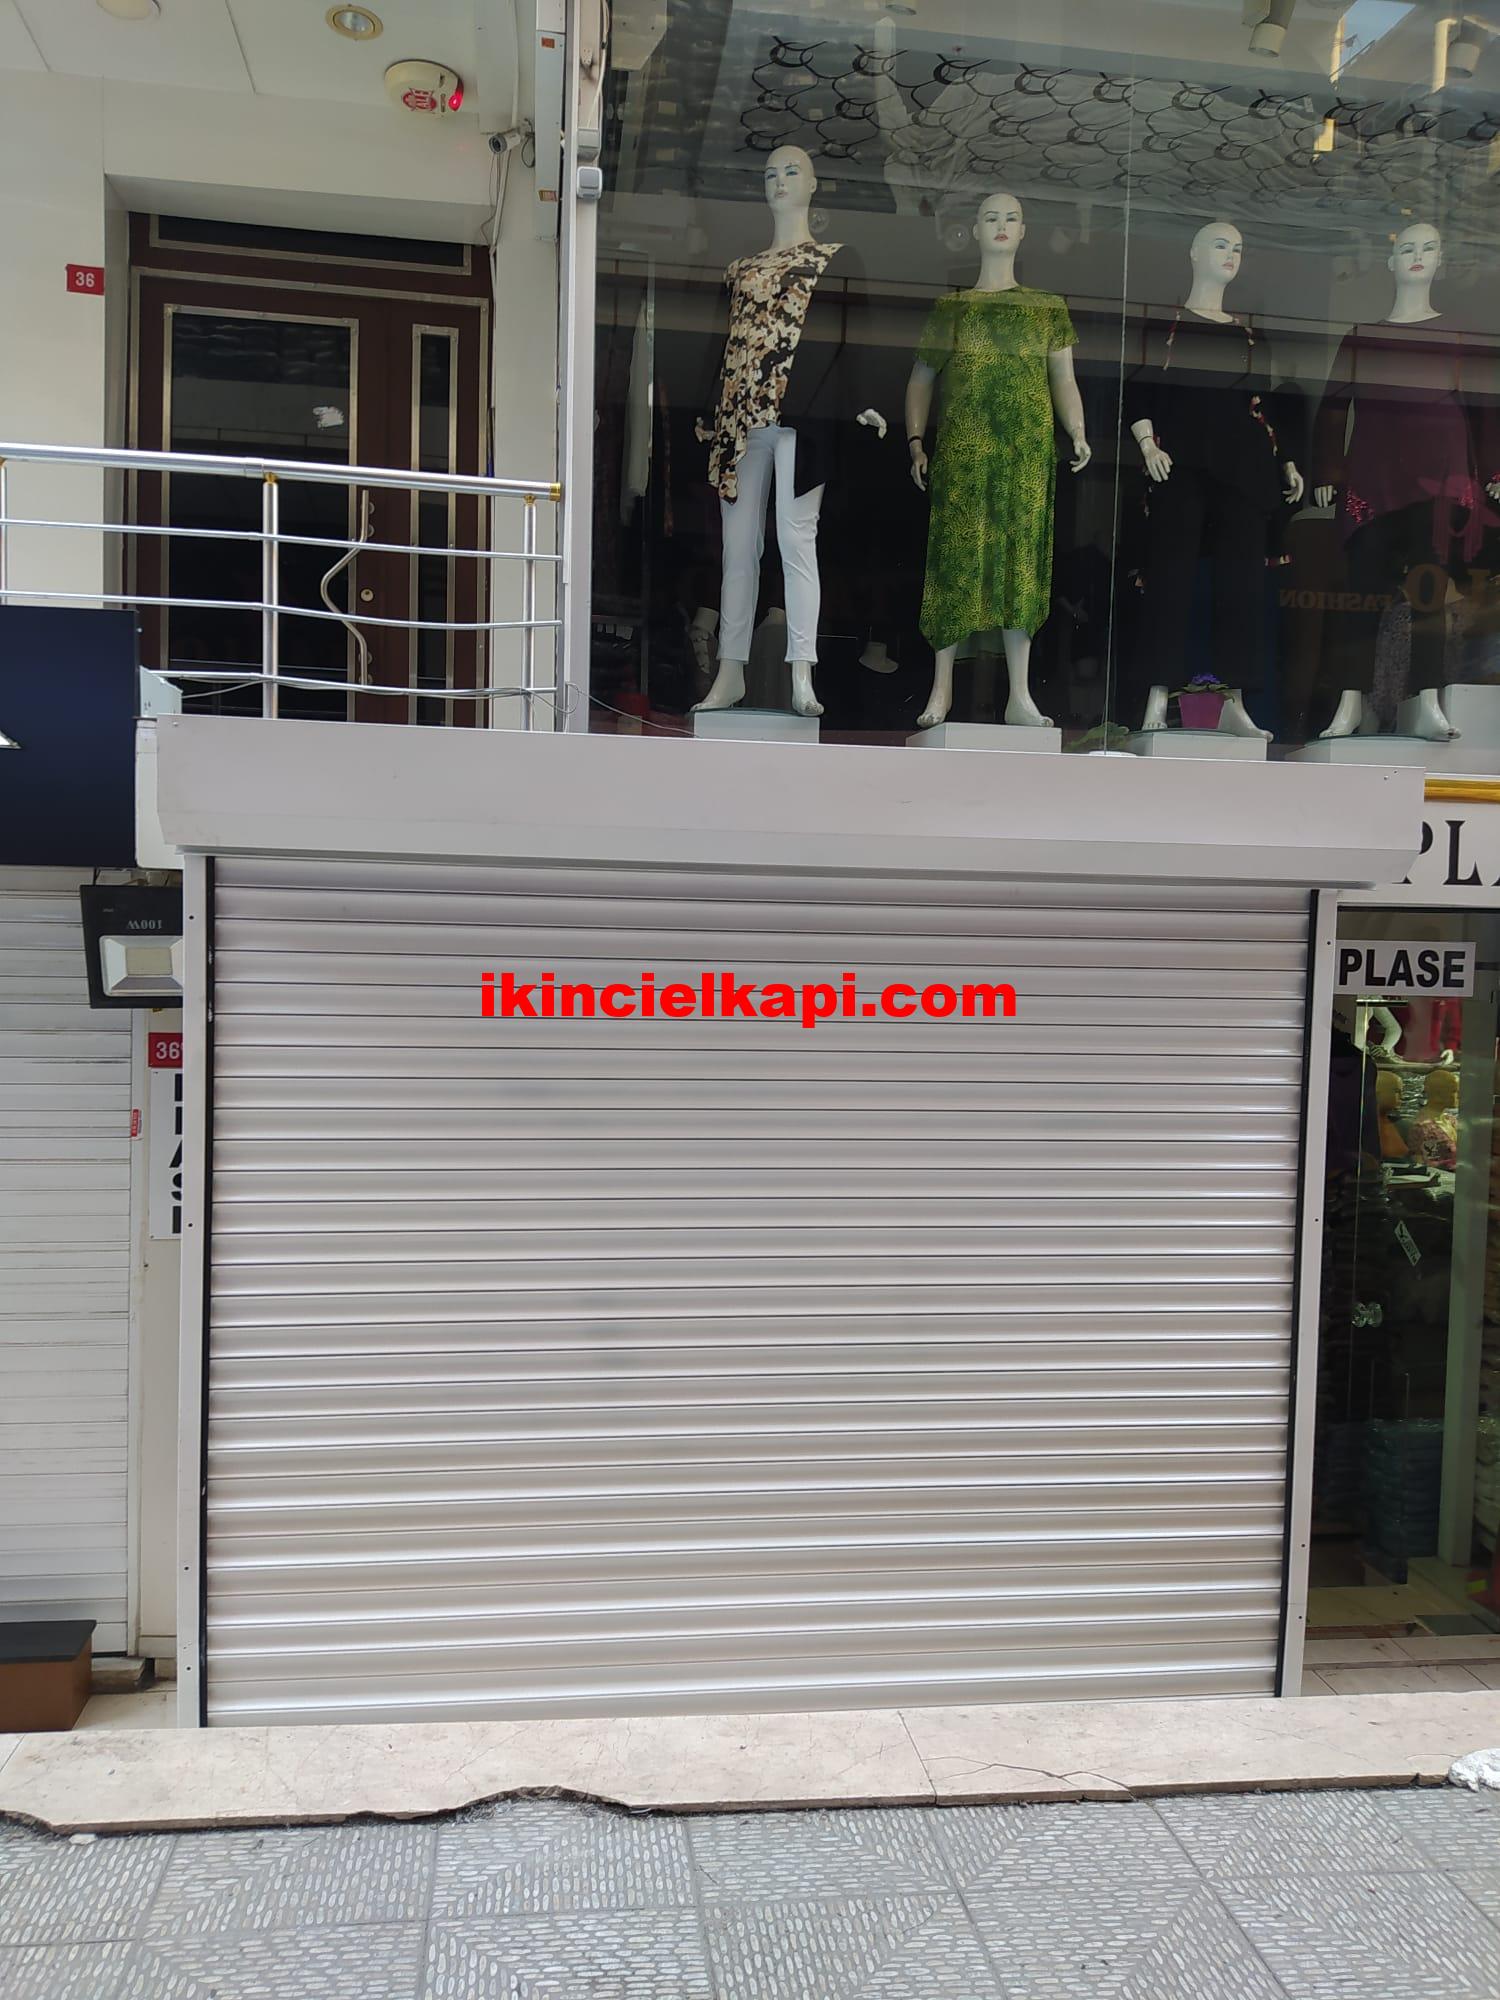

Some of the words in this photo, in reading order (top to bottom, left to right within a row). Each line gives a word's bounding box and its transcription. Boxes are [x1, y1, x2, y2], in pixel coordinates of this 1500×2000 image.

[75, 271, 95, 288] 36
[126, 919, 162, 930] 100W
[1338, 949, 1466, 988] PLASE
[156, 1041, 183, 1060] 36
